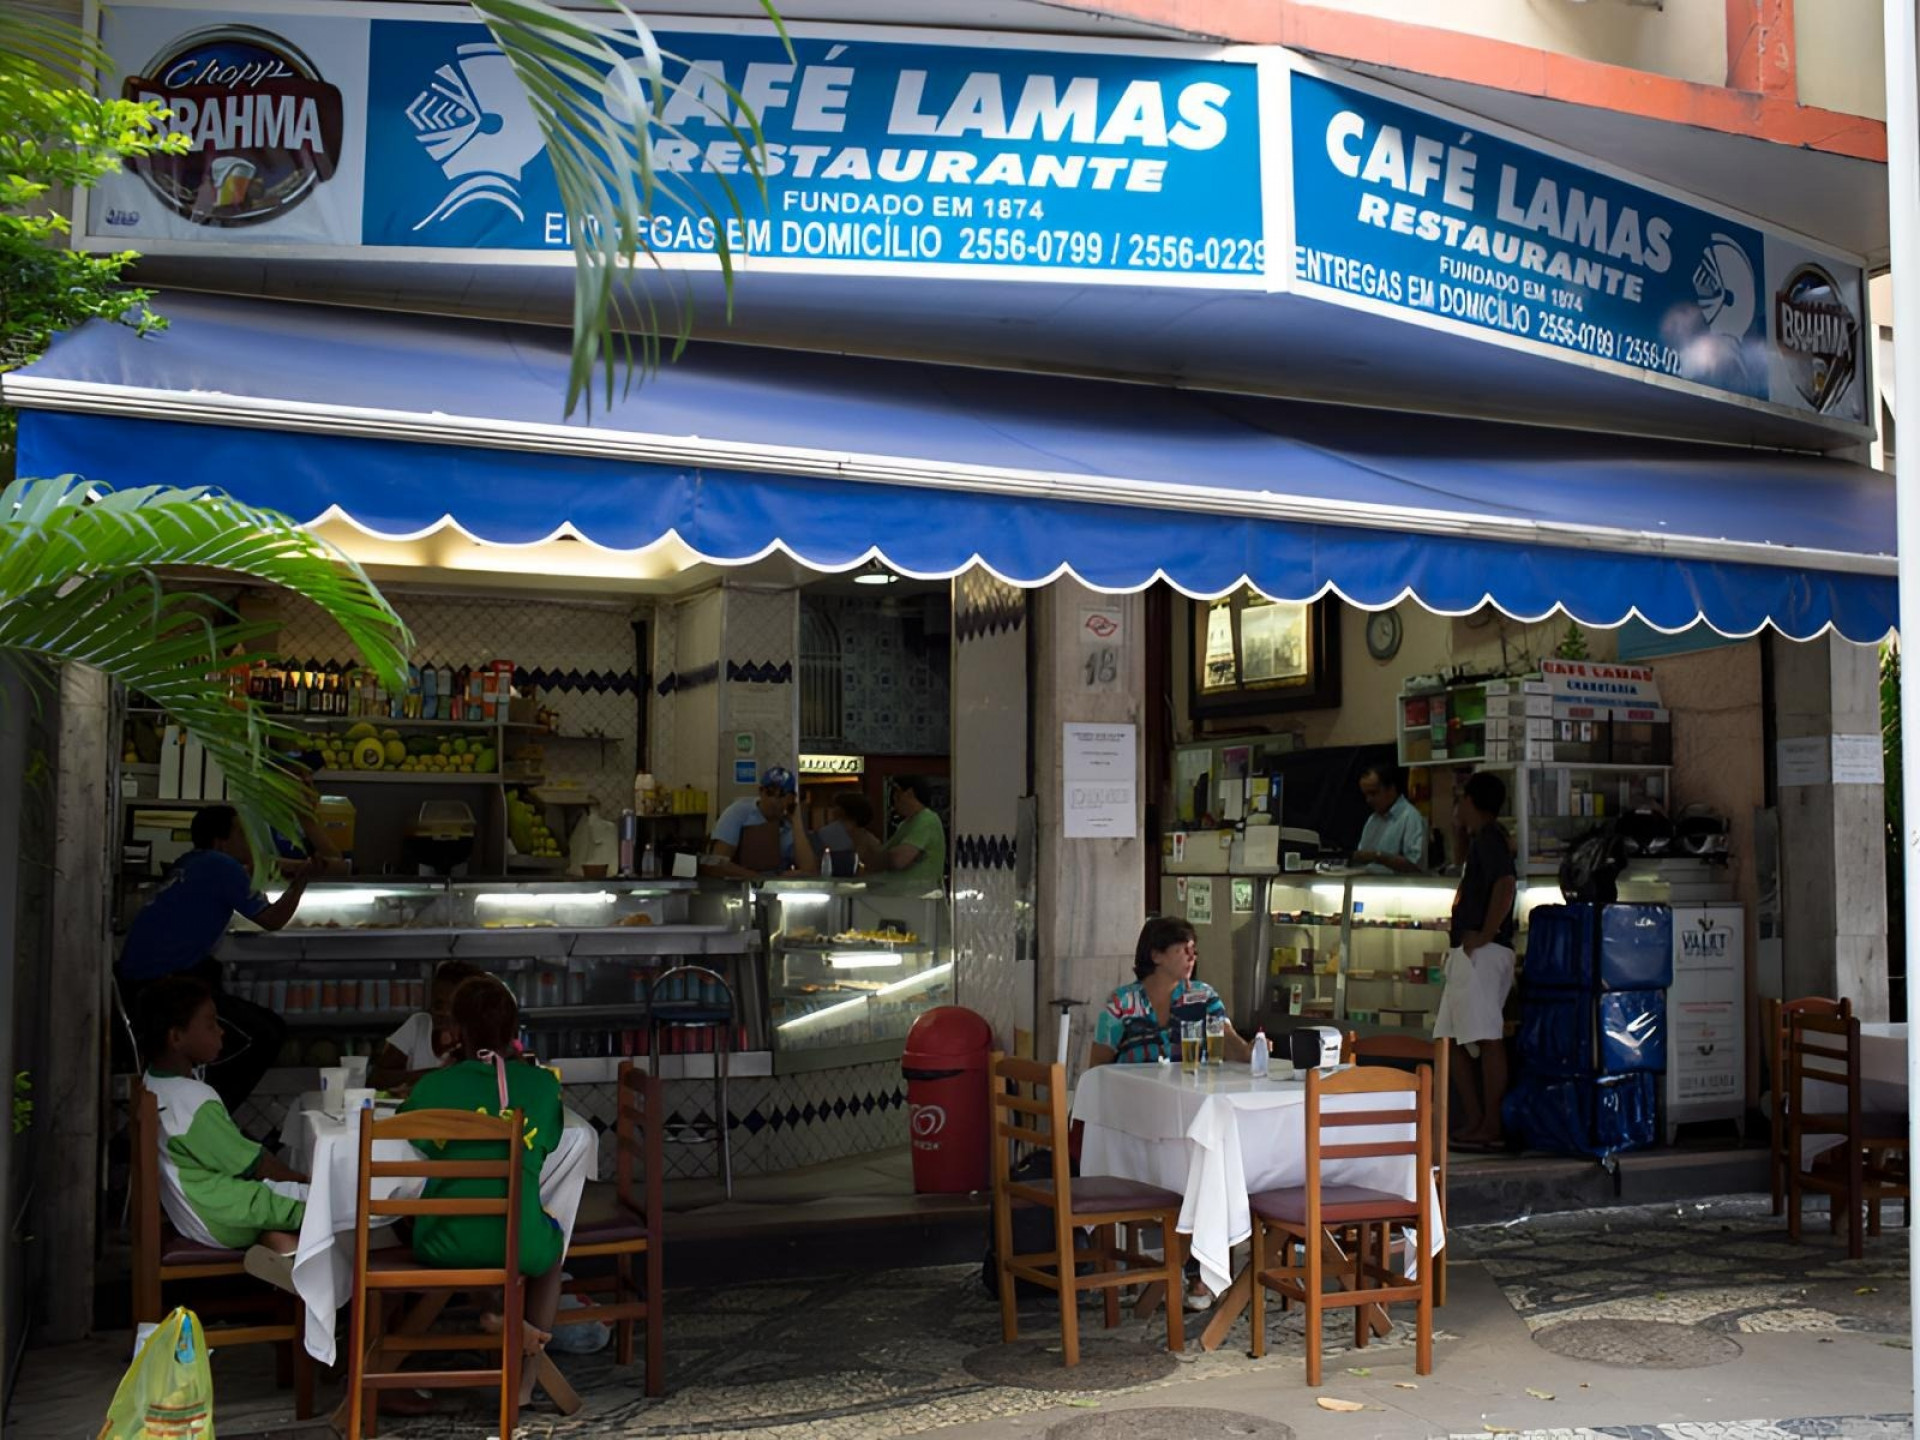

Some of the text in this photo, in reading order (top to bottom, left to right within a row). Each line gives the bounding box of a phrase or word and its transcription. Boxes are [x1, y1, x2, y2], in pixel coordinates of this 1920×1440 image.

[165, 58, 294, 90] Chopp
[603, 45, 1232, 150] CAFÉ LAMAS
[137, 91, 324, 154] BRAHMA
[652, 138, 1169, 192] RESTAURANTE
[1325, 110, 1673, 274] CAFÉ LAMAS
[783, 190, 1044, 221] FUNDADO EM 1874
[726, 218, 771, 252] EM
[781, 216, 942, 258] DOMICÍLIO
[959, 227, 1102, 264] 2556-0799
[1110, 233, 1121, 265] /
[1128, 234, 1265, 271] 2556-0229
[1357, 192, 1644, 303] RESTAURANTE
[1296, 246, 1403, 301] ENTREGAS
[1408, 275, 1434, 308] EM
[1439, 255, 1584, 313] FUNDADO EM 1874
[1781, 302, 1852, 362] BRAHMA
